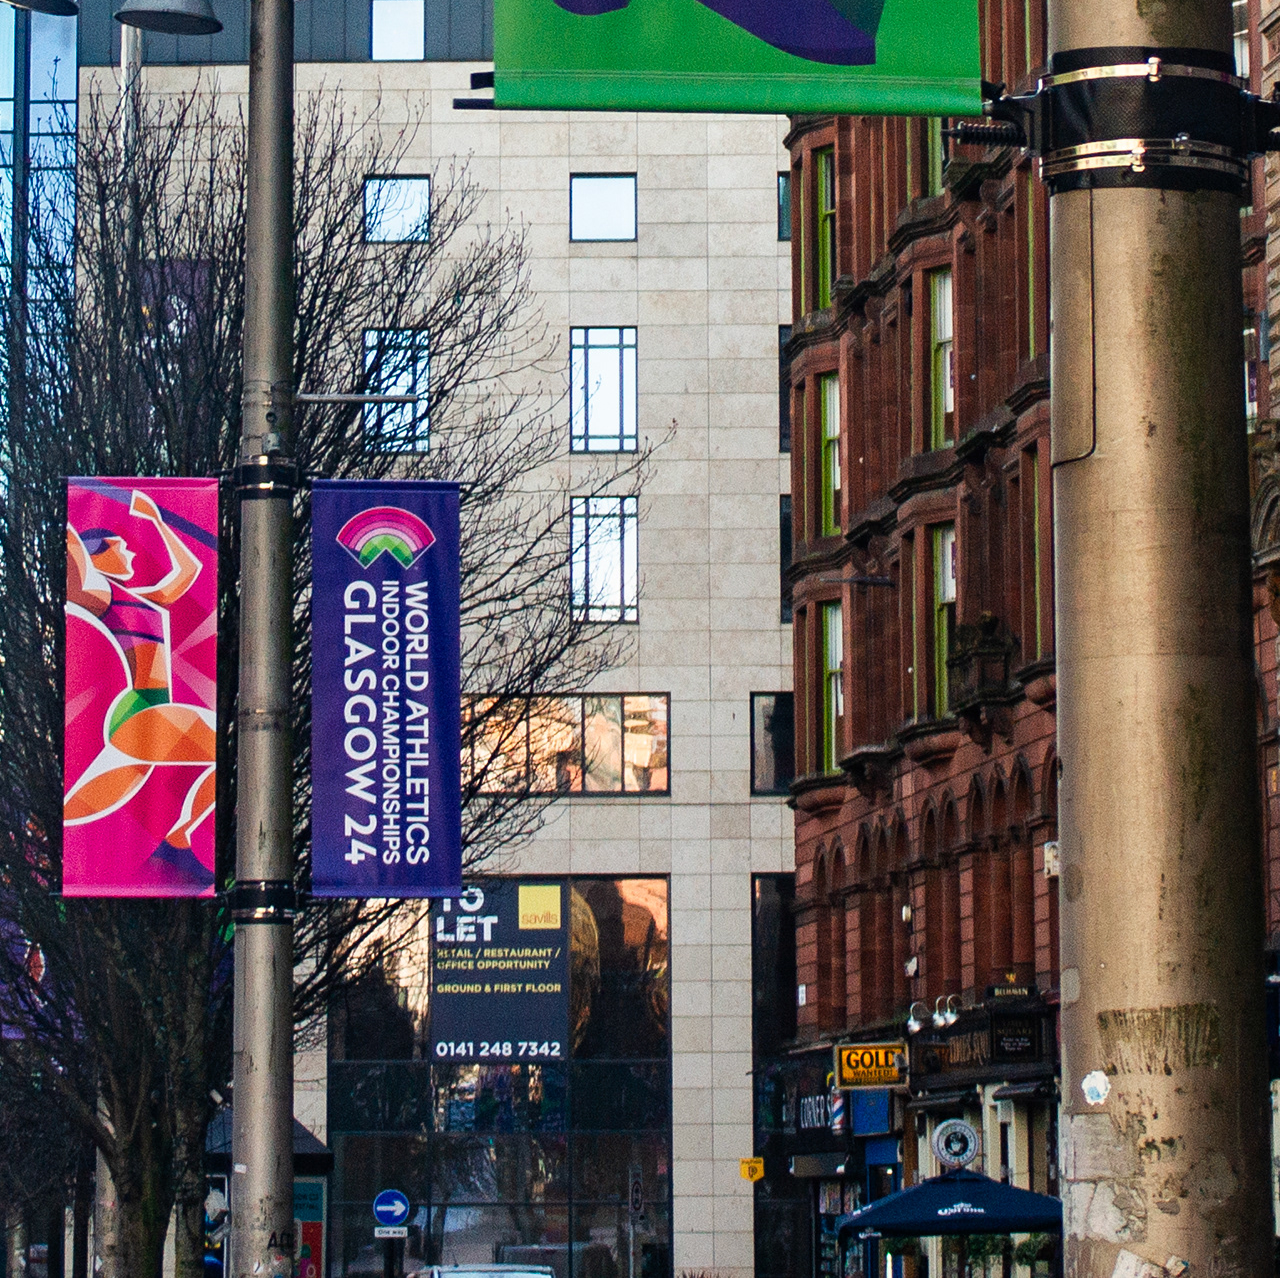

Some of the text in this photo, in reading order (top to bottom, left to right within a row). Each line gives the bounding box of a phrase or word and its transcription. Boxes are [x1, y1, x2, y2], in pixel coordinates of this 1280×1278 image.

[343, 580, 378, 865] GLASGOW 24
[381, 579, 401, 865] INDOOR CHAMPIONSHIPS
[405, 580, 430, 865] WORLD ATHLETICS
[521, 911, 558, 925] savills
[436, 915, 499, 942] LET
[483, 948, 553, 959] RESTAURANT
[476, 959, 551, 970] OPPORTUNITY
[436, 983, 562, 994] GROUND & FIRST FLOOR
[436, 1041, 562, 1057] 0141 248 7342
[846, 1049, 896, 1070] GOLD
